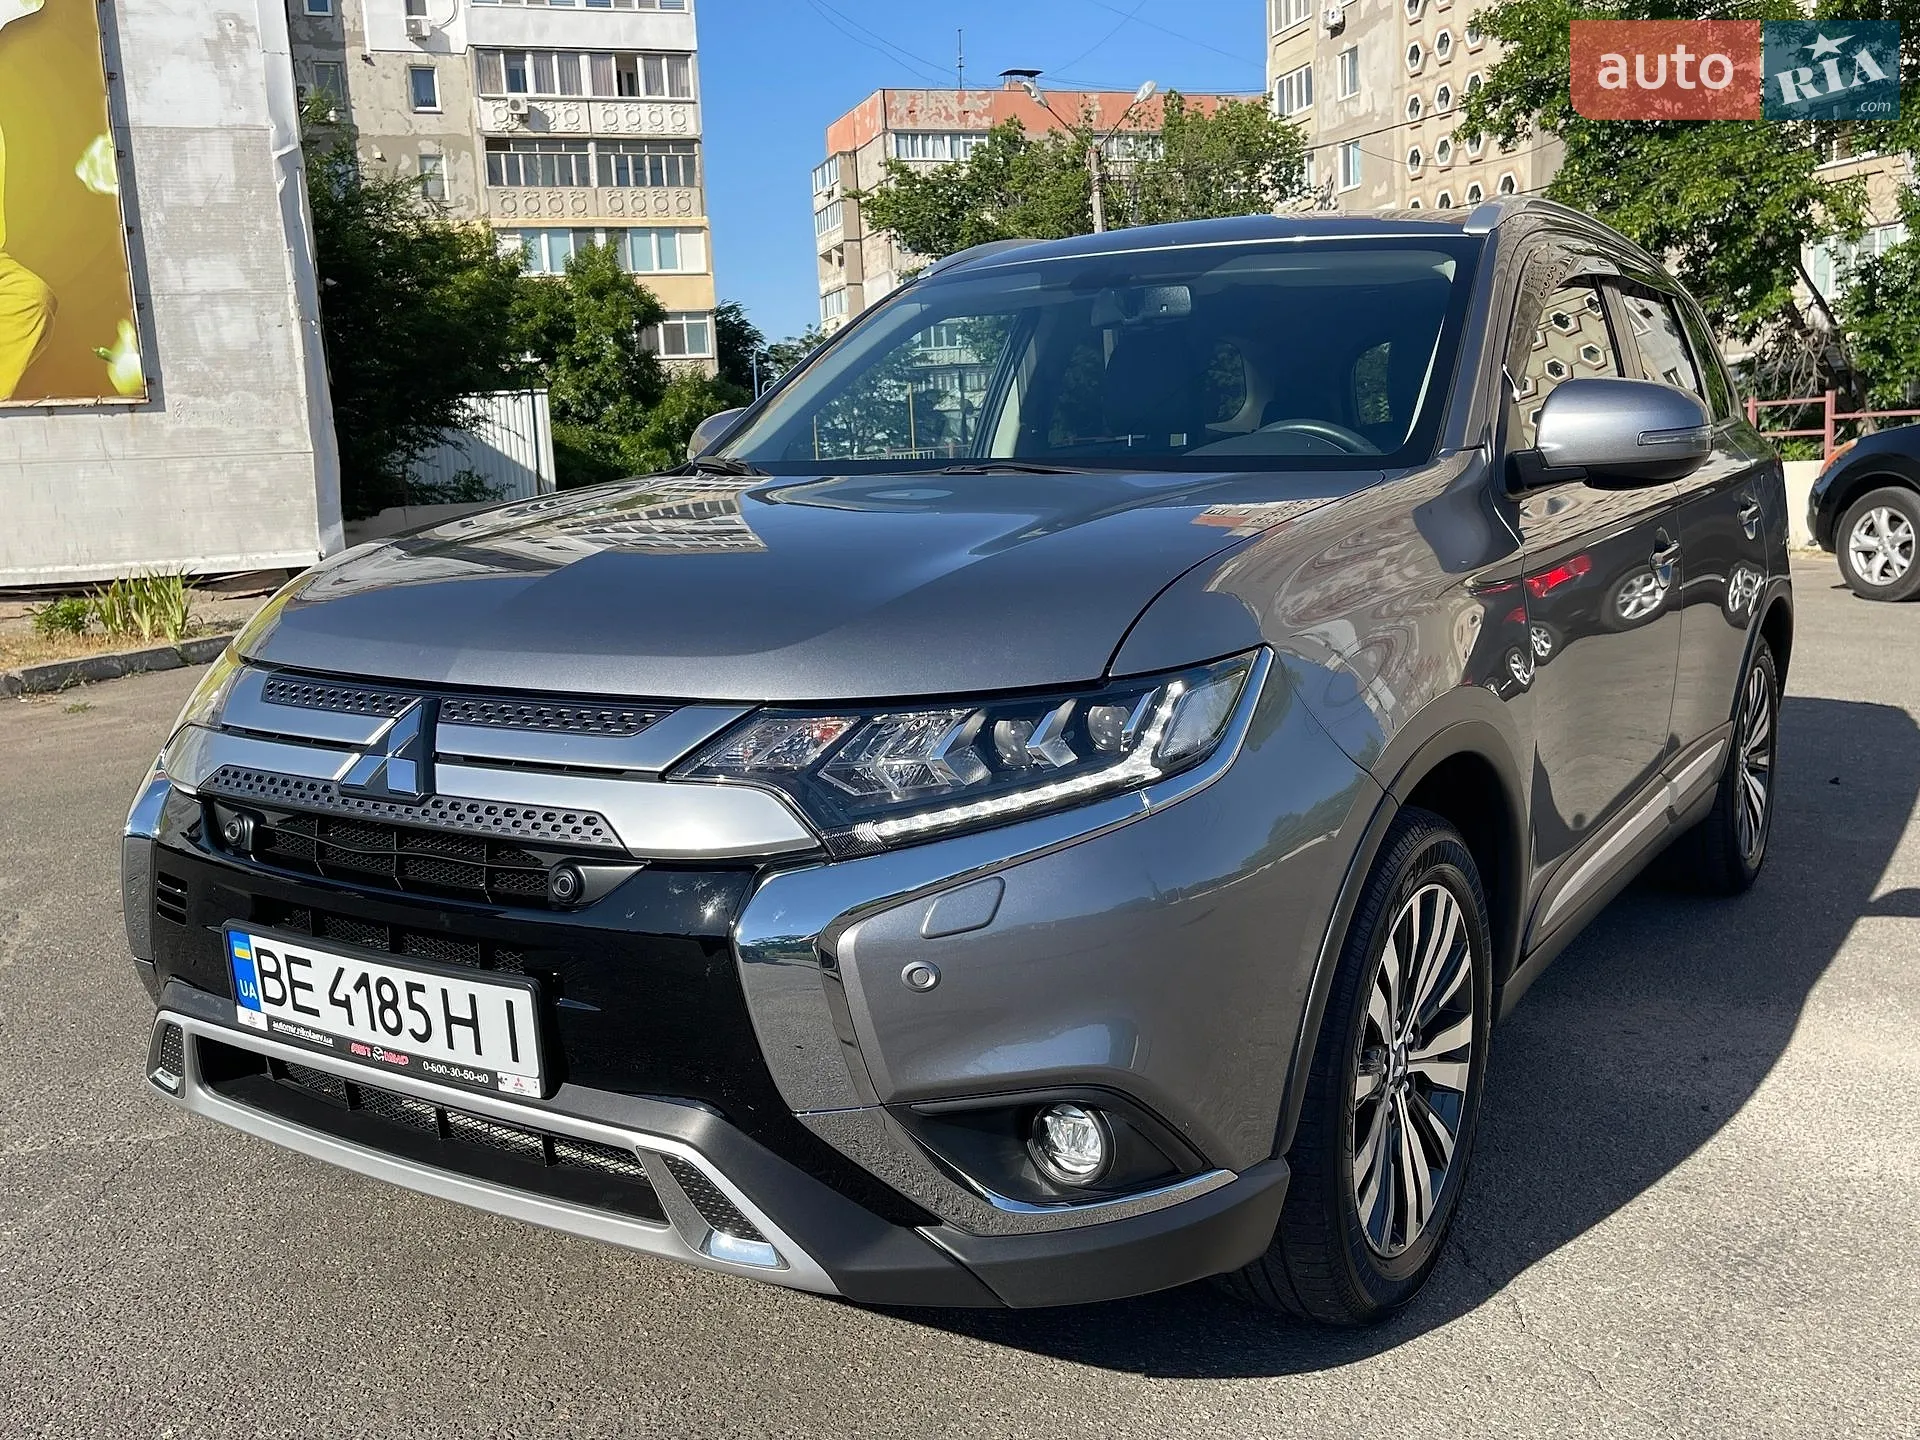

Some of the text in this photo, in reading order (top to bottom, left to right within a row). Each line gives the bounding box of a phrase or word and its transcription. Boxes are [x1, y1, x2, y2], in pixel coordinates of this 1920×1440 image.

[239, 979, 258, 1001] UA
[255, 947, 320, 1018] BE
[328, 967, 432, 1043] 4185
